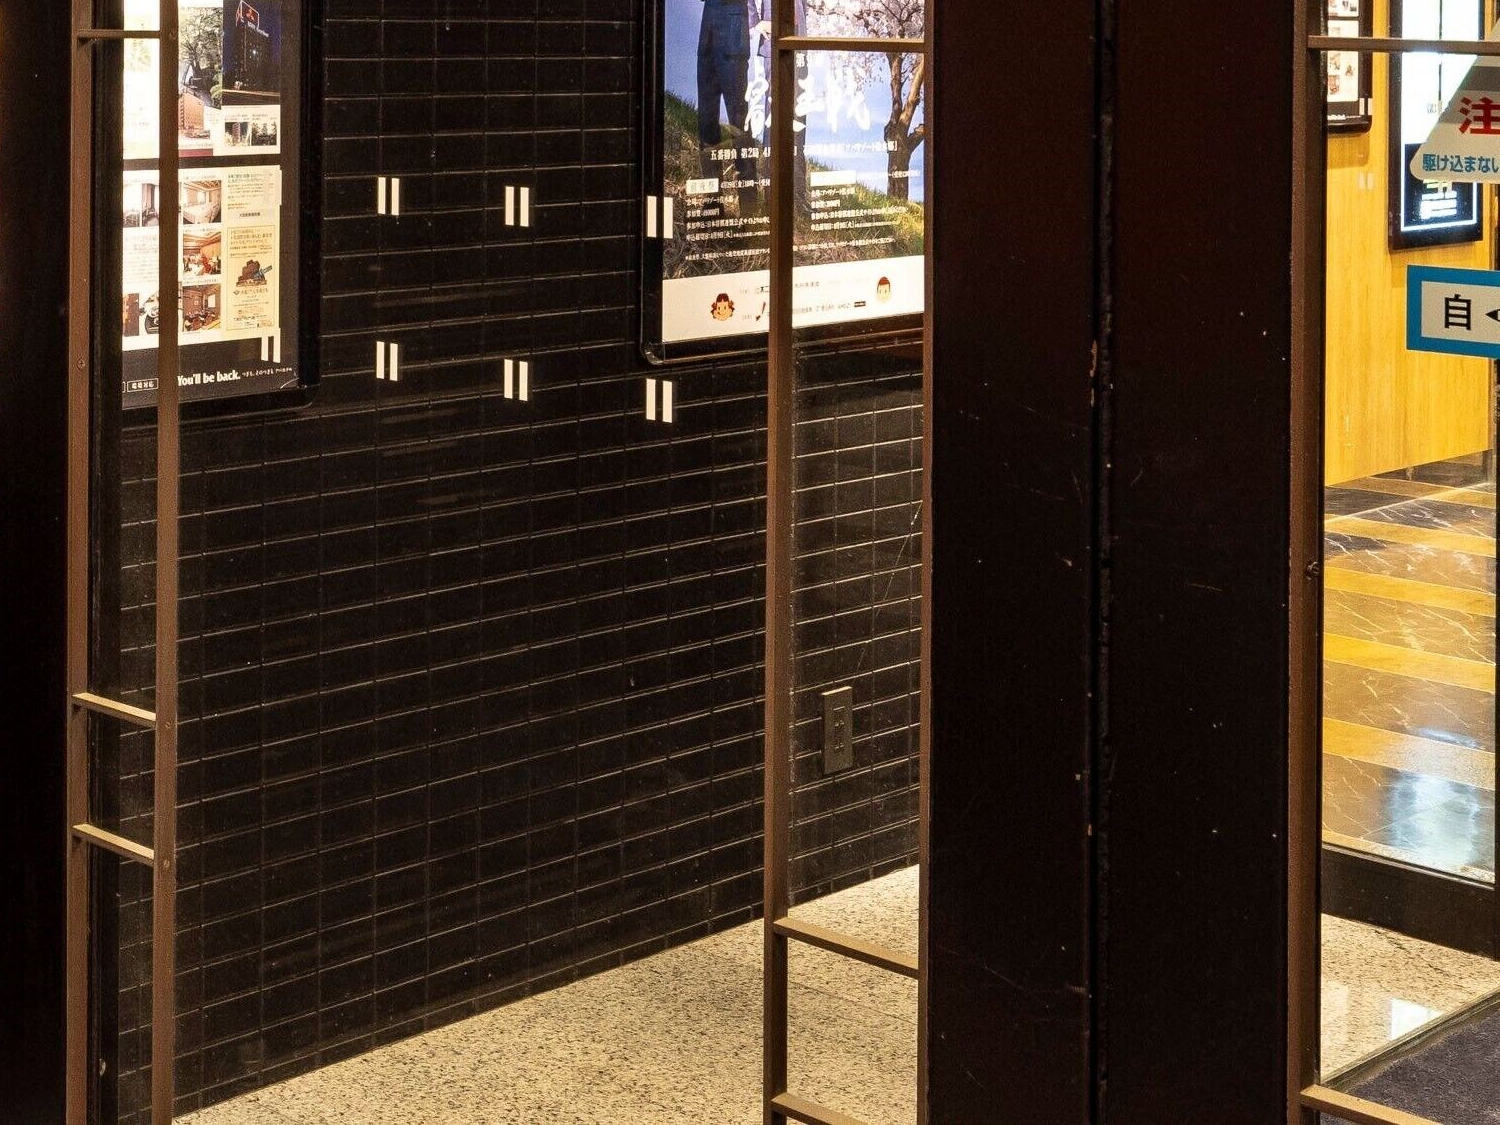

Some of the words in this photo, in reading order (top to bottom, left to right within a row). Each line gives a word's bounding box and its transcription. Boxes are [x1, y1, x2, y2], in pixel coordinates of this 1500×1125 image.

[1444, 293, 1472, 331] 自
[178, 373, 201, 386] You'll
[203, 371, 214, 383] be
[217, 370, 241, 382] back.
